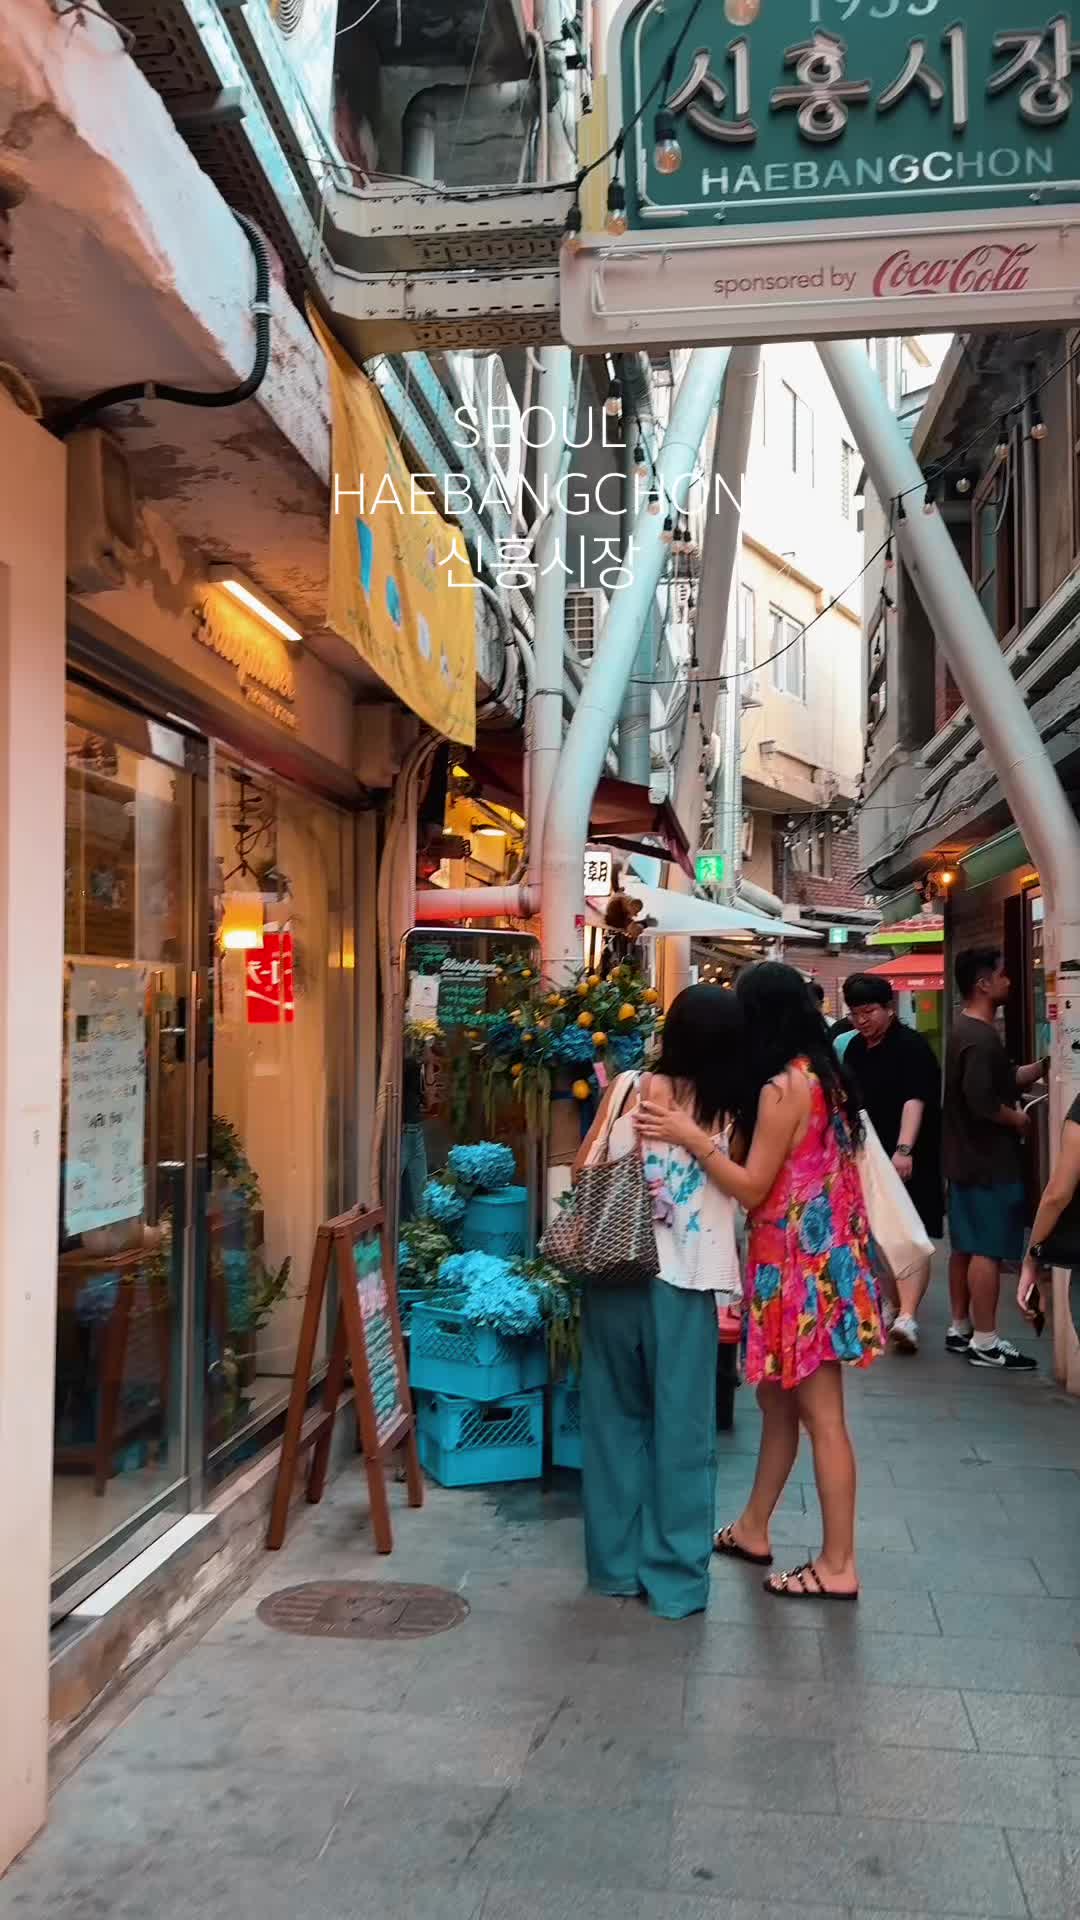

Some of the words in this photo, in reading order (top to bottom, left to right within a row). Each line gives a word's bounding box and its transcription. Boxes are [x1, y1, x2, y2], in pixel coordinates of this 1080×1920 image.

[666, 14, 1080, 143] 신흥시장
[702, 146, 1054, 196] HAEBANGCHON
[714, 270, 824, 295] sponsored
[831, 266, 857, 291] by
[873, 242, 1039, 297] Coca-Cola
